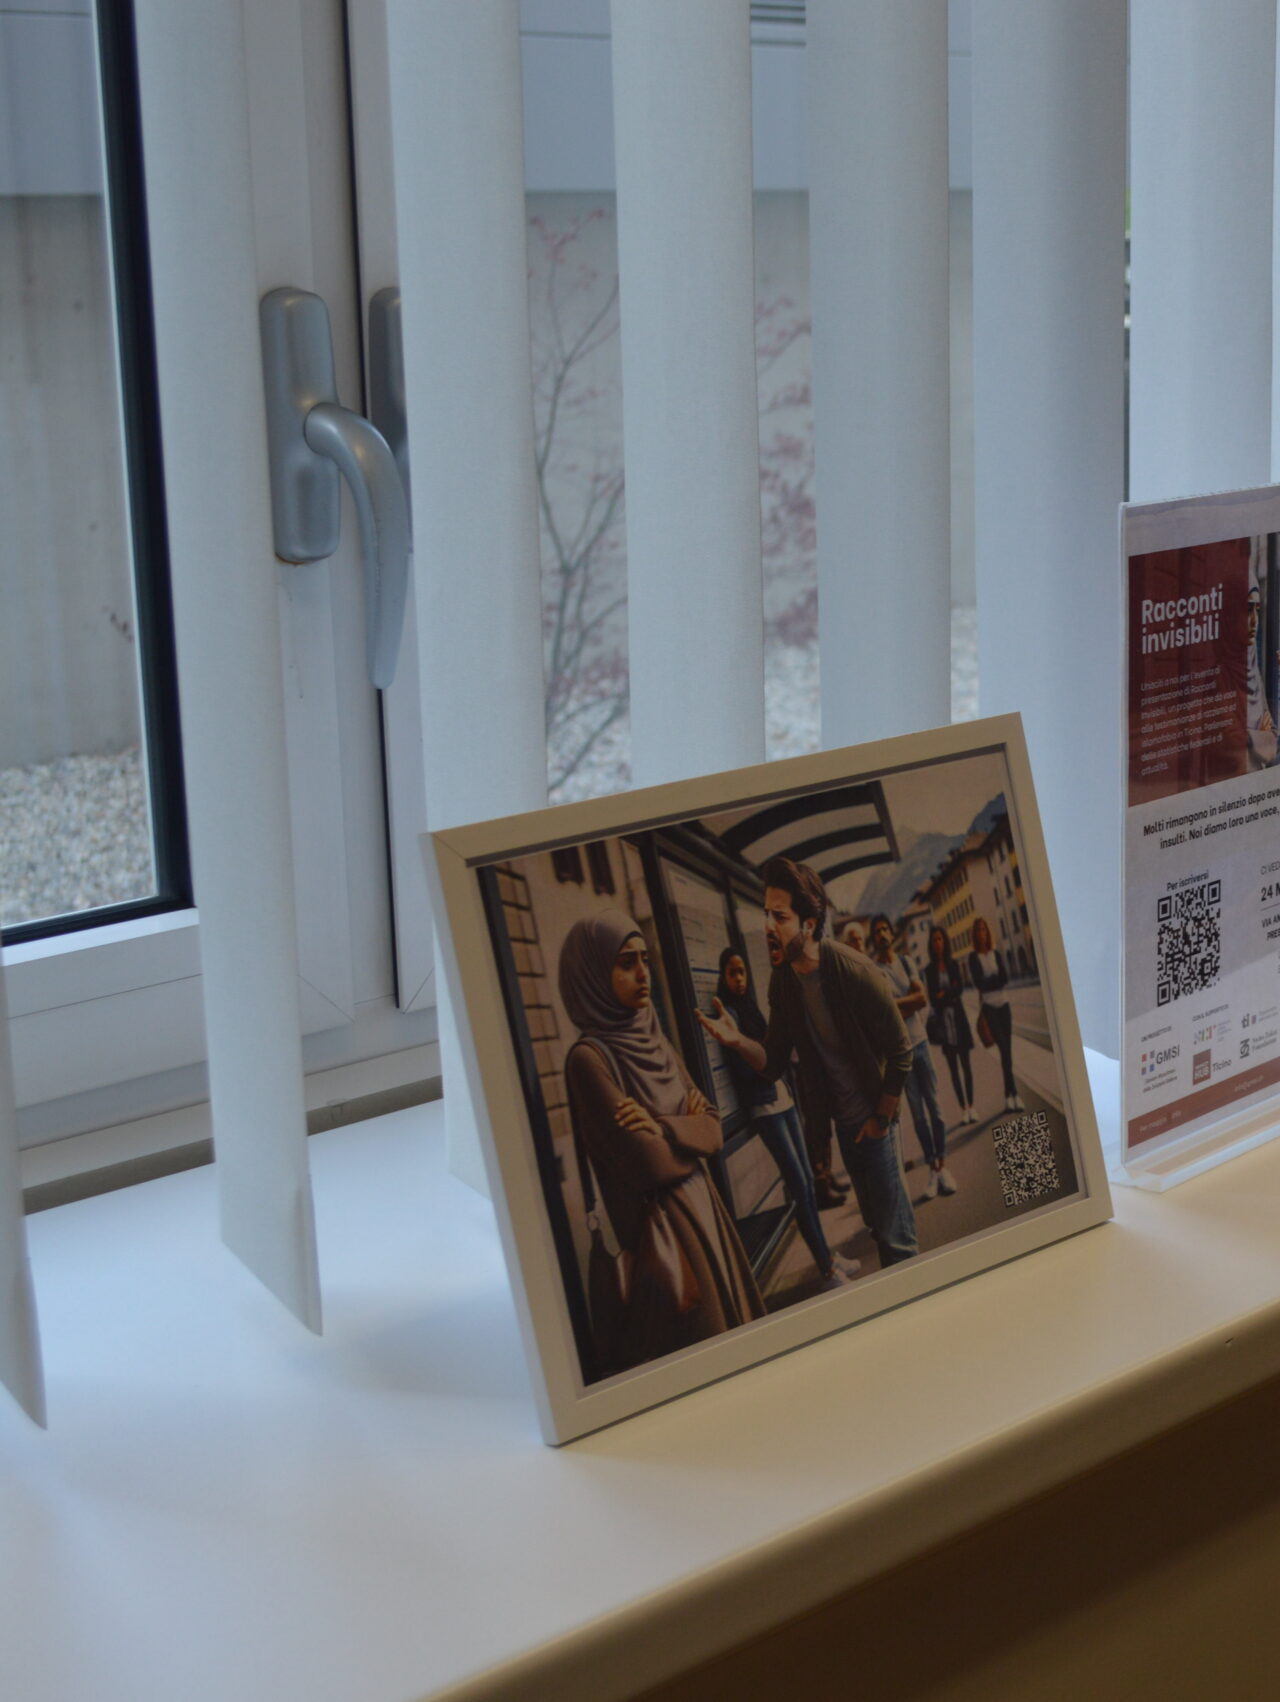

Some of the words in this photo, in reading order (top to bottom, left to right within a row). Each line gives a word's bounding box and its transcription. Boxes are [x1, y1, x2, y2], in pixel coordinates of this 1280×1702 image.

[1141, 584, 1223, 624] Racconti
[1141, 618, 1220, 655] invisibili
[1143, 819, 1164, 836] Molti
[1165, 807, 1208, 832] rimangono
[1209, 804, 1217, 817] in
[1218, 796, 1247, 814] silenzio
[1248, 790, 1266, 808] dopo
[1160, 831, 1188, 849] insulti.
[1189, 827, 1203, 840] Noi
[1204, 820, 1227, 836] diamo
[1229, 814, 1244, 828] loro
[1245, 812, 1259, 823] una
[1260, 806, 1280, 821] voce,
[1260, 865, 1267, 876] CI
[1167, 880, 1177, 892] Per
[1179, 870, 1209, 888] iscriversi
[1261, 885, 1273, 902] 24
[1261, 917, 1272, 928] VIA
[1156, 1045, 1180, 1065] GMSI
[1212, 1056, 1232, 1073] Ticino
[1194, 1067, 1210, 1080] HUB
